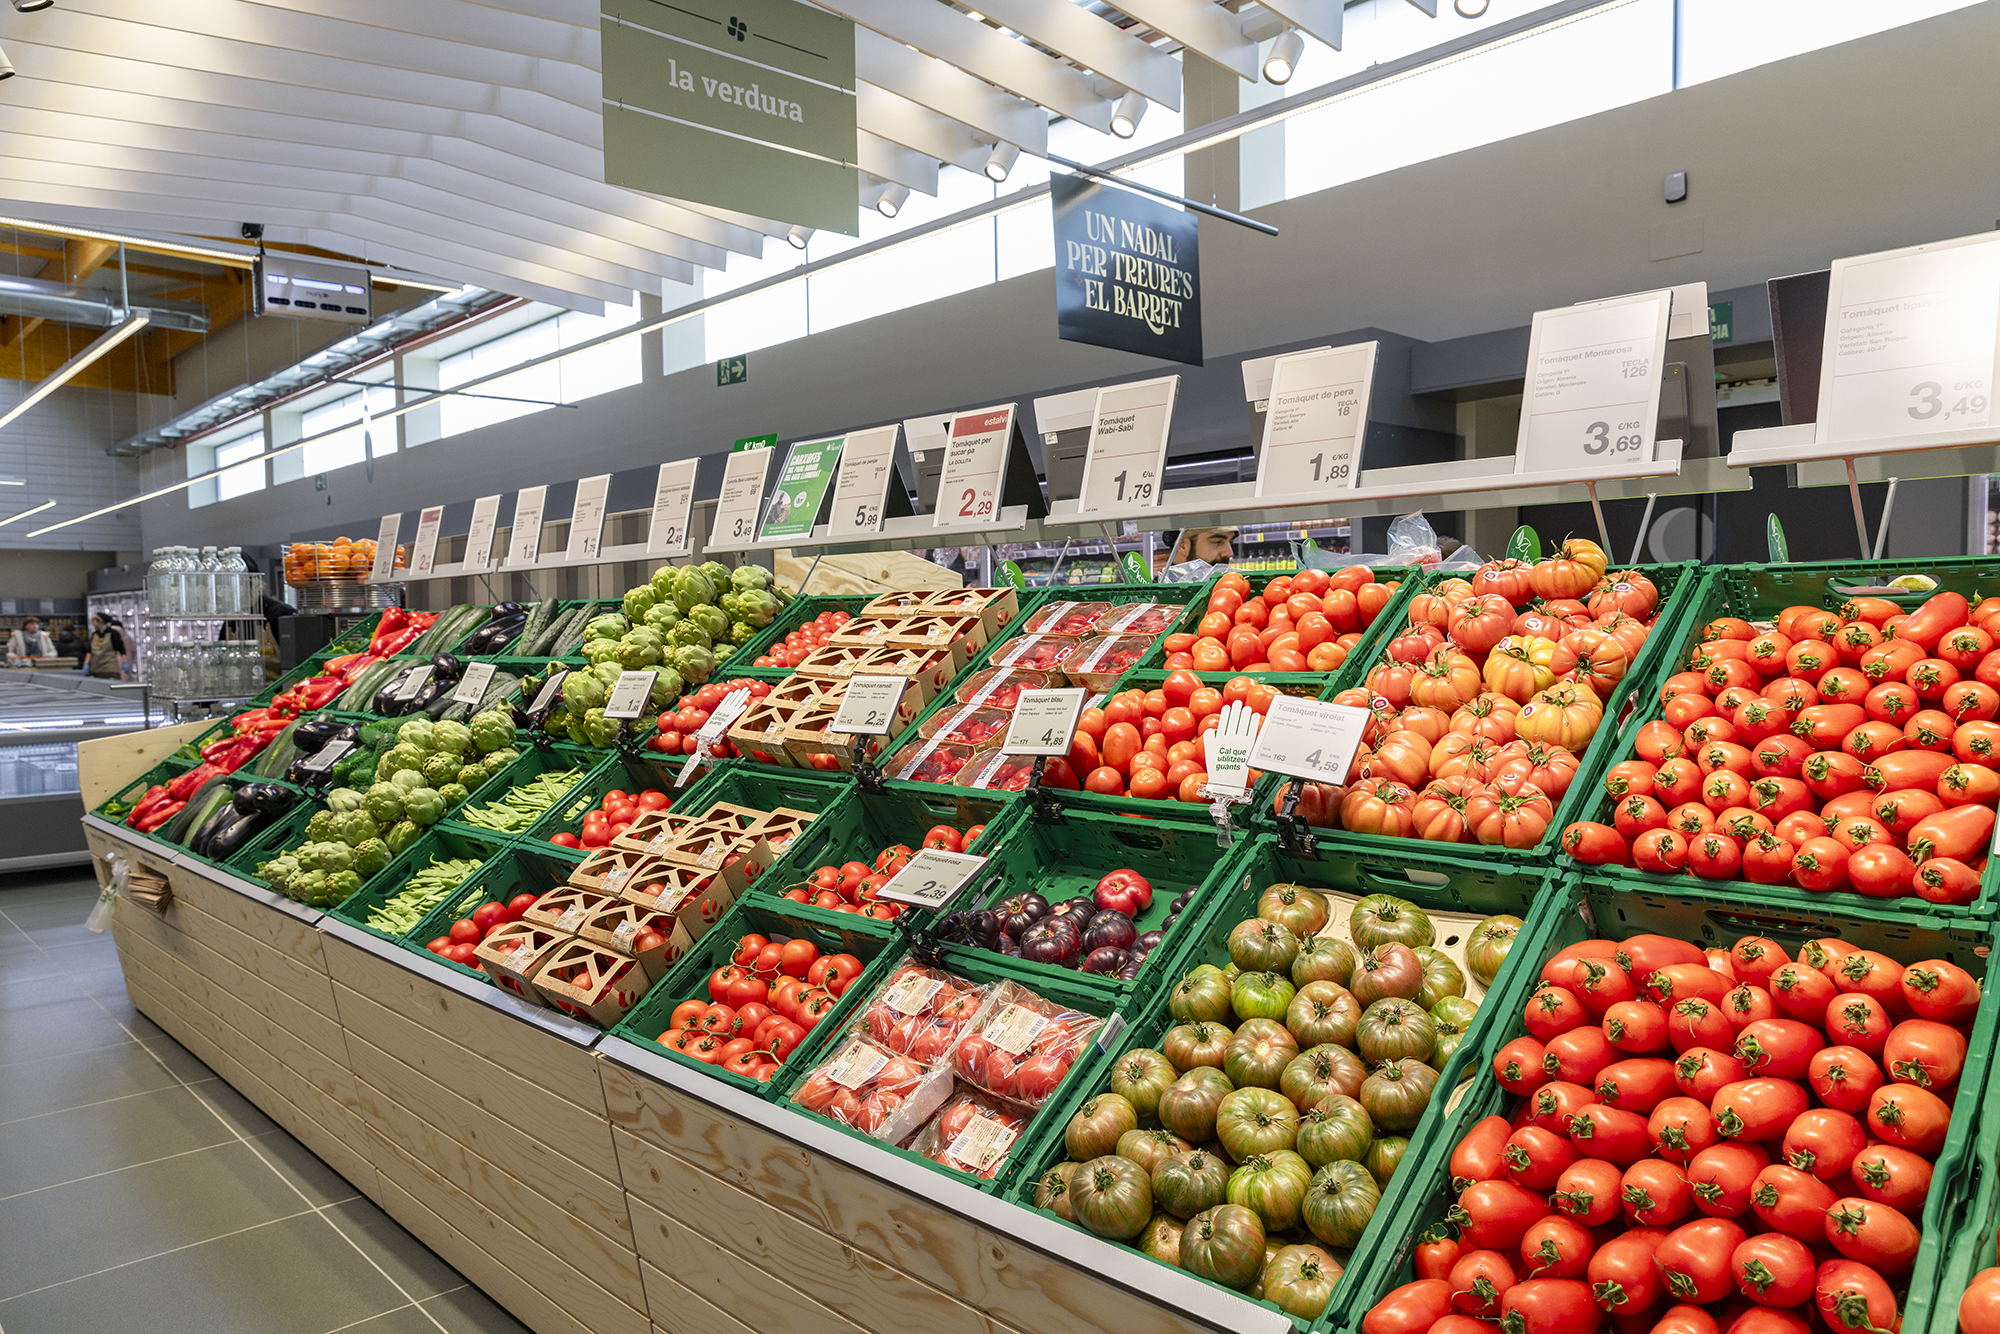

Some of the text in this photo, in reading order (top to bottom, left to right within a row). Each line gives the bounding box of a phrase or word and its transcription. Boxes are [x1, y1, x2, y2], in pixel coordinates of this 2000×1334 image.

[668, 58, 804, 123] la verdura
[1085, 210, 1178, 264] UN NADAL
[1066, 240, 1194, 300] PER TREURE'S
[1084, 278, 1183, 335] EL BARRET
[1842, 304, 1900, 320] Tomàquet
[1902, 298, 1932, 312] tipus
[1539, 346, 1633, 366] Tomàquet Monterosa
[1621, 358, 1650, 368] TECLA
[1622, 365, 1648, 379] 126
[1557, 380, 1587, 389] Monterosa
[1953, 380, 1984, 392] €/KG
[1277, 388, 1354, 406] Tomàquet de pera
[1337, 399, 1359, 407] TECLA
[1907, 380, 1988, 421] 3,49
[1337, 406, 1350, 417] 18
[984, 414, 1008, 427] estalvi
[1100, 414, 1135, 427] Tomàquet
[1618, 420, 1640, 430] €/KG
[1098, 423, 1134, 436] Wabi-Sabi
[952, 437, 992, 449] Tomàquet per
[1583, 420, 1642, 456] 3,69
[790, 451, 823, 467] CARXOFES
[950, 448, 975, 458] sucar pa
[1332, 452, 1349, 461] €/KG
[954, 458, 972, 466] COLLITA
[1310, 452, 1349, 483] 1,89
[1114, 470, 1152, 503] 1,79
[958, 488, 992, 518] 2,29
[855, 505, 878, 527] 5,99
[733, 517, 752, 538] 3,49
[666, 526, 683, 546] 2,49
[864, 710, 886, 727] 2,25
[1278, 703, 1345, 722] Tomàquet virolat
[1041, 728, 1064, 747] 4,89
[1219, 747, 1247, 756] Cal que
[1273, 753, 1286, 762] 163
[1215, 762, 1241, 772] guants
[1217, 756, 1247, 764] utilitzeu
[1305, 749, 1339, 773] 4,59
[921, 854, 962, 866] Tomàquet rosa
[913, 880, 947, 899] 2,39
